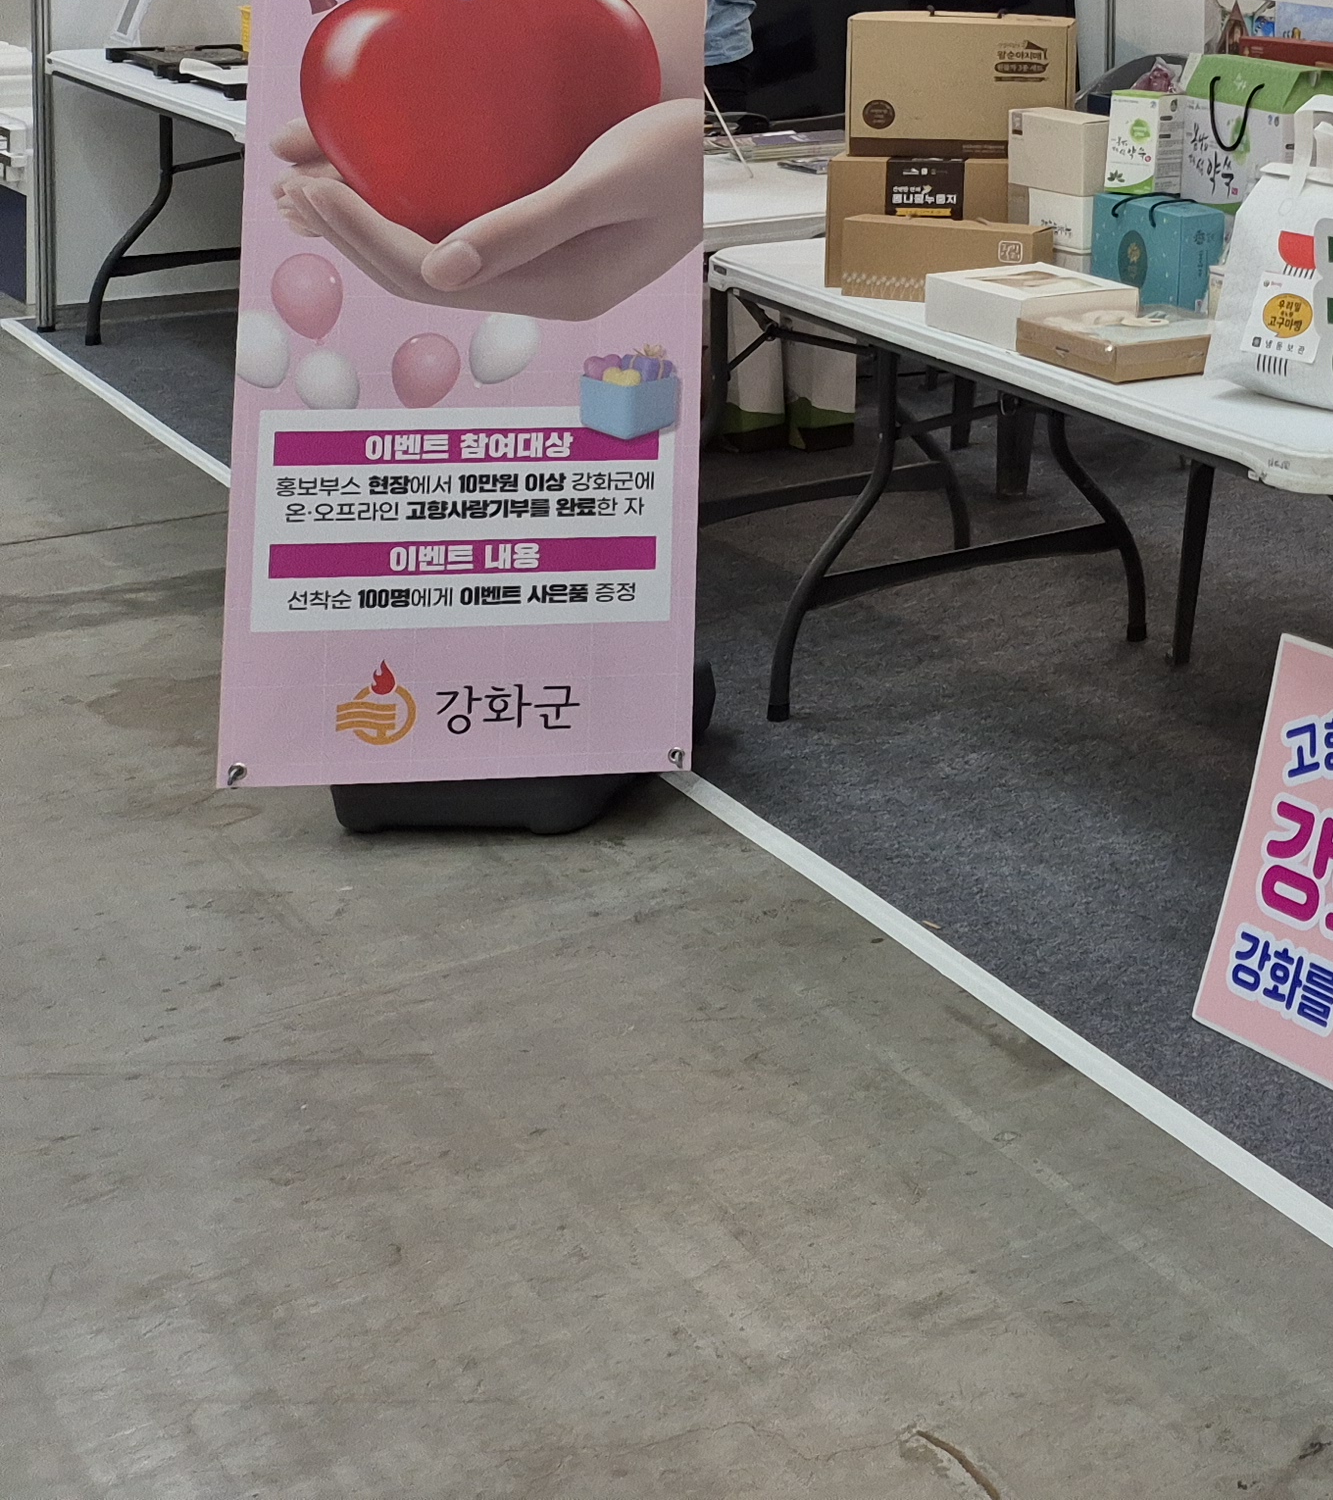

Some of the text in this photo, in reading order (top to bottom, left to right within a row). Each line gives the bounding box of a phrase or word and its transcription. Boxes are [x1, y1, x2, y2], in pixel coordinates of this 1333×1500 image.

[365, 431, 573, 461] 이벤트 참여대상
[276, 471, 655, 497] 홍보부스 현장에서 10만원 이상 강화군에
[285, 496, 644, 524] 온·오프라인 고향사랑기부를 완료한 자
[390, 543, 540, 572] 이벤트 내용
[287, 582, 637, 611] 선착순 100명에게 이벤트 사은품 증정
[436, 684, 581, 735] 강화군
